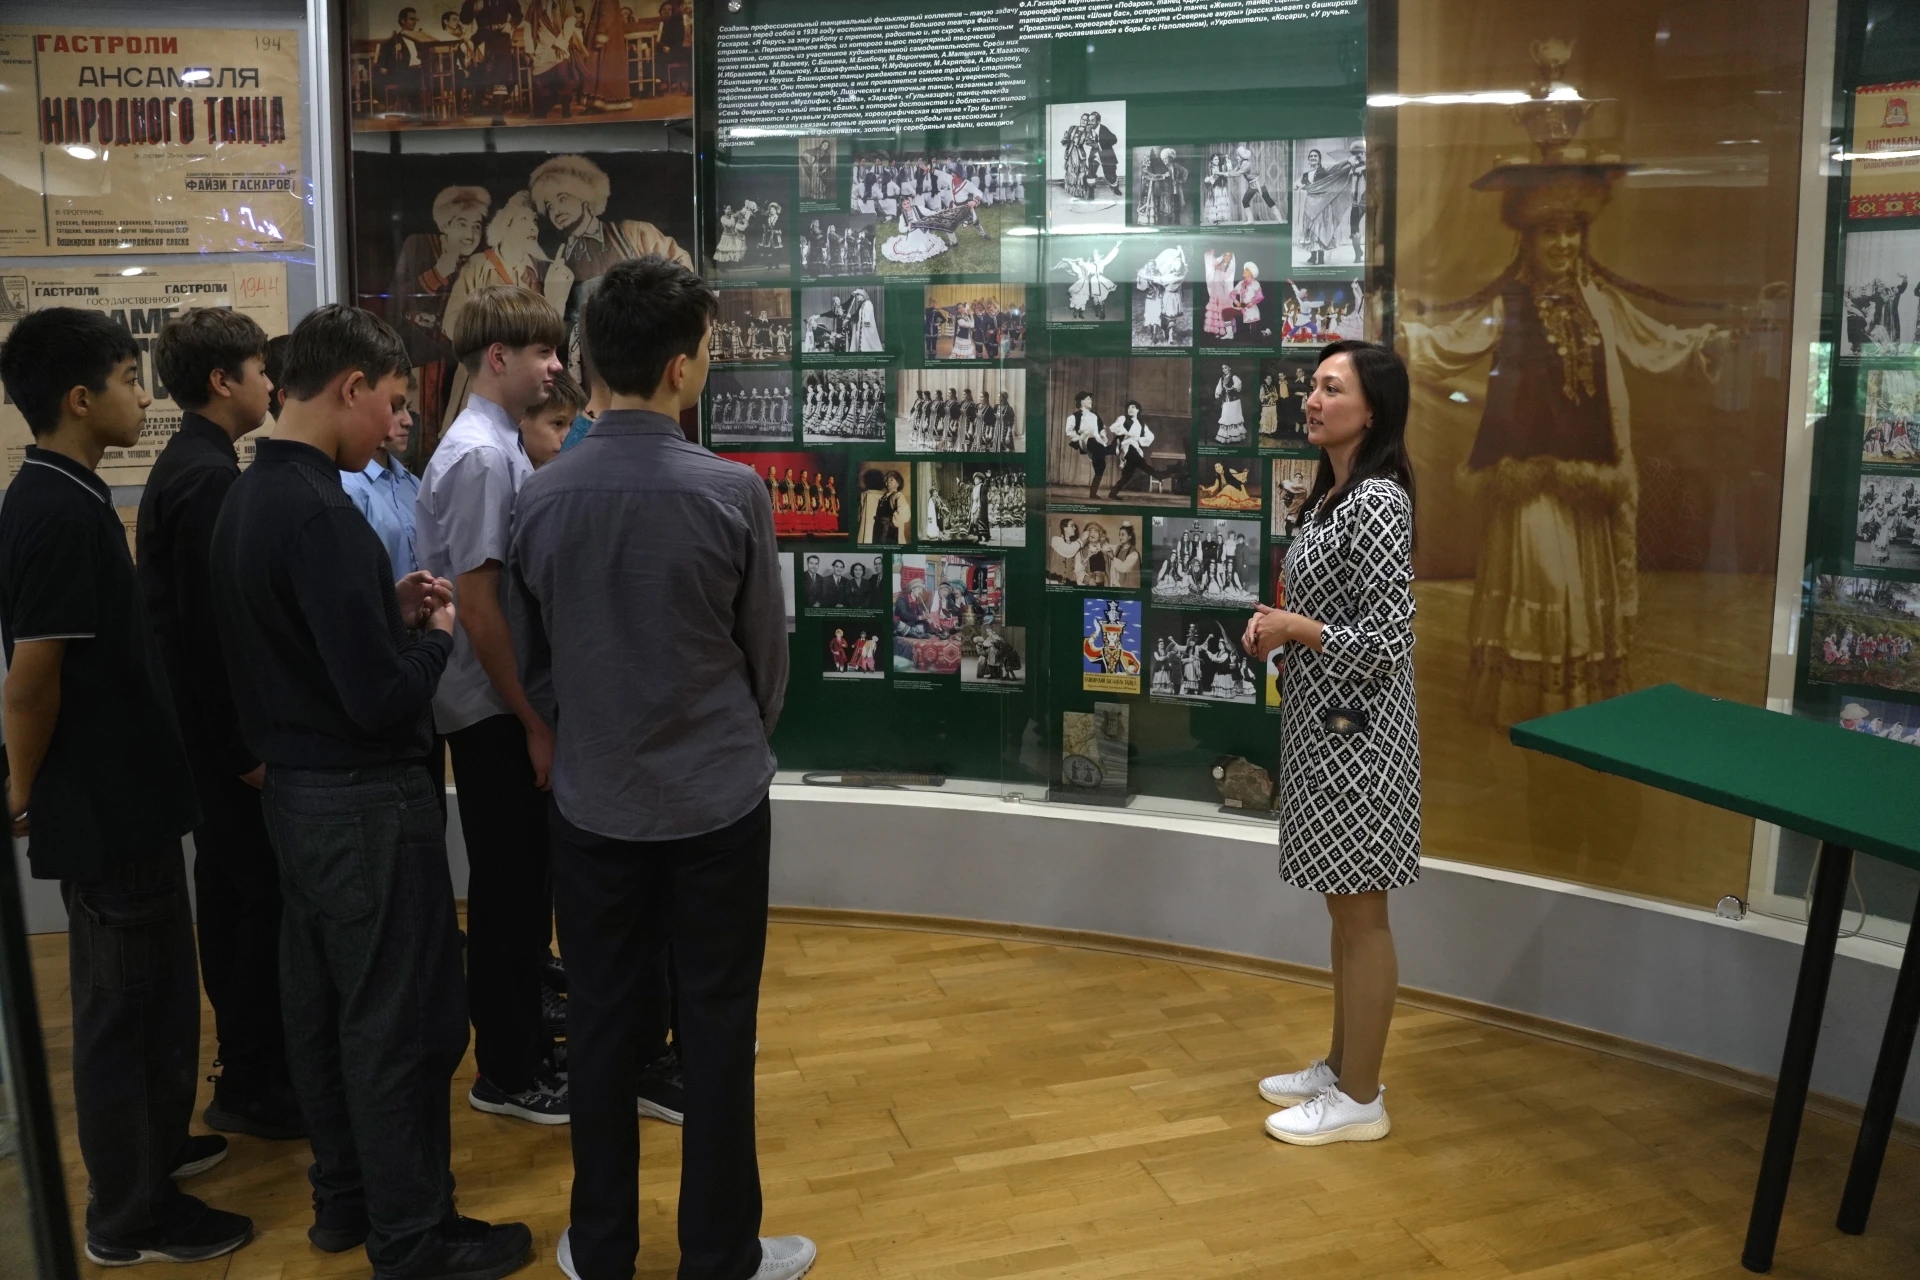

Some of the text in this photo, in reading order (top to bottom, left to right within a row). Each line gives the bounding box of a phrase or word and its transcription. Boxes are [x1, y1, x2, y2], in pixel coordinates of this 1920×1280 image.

[1018, 15, 1059, 25] татарский
[1061, 14, 1085, 22] танец
[1133, 5, 1181, 16] остроумный
[1183, 4, 1207, 12] танец
[1209, 1, 1244, 9] «Жених»,
[1019, 6, 1086, 16] хореографическая
[1087, 4, 1112, 12] сценка
[1114, 0, 1155, 9] «Подарок»,
[1019, 24, 1073, 33] «Проказницы»,
[1074, 18, 1142, 29] хореографическая
[1172, 13, 1213, 21] «Северные
[1214, 10, 1243, 18] амуры»
[1245, 5, 1302, 16] (рассказывает
[1311, 0, 1357, 9] башкирских
[717, 32, 751, 40] поставил
[752, 30, 773, 38] перед
[774, 28, 795, 36] собой
[803, 27, 818, 35] 1938
[819, 26, 835, 34] году
[836, 24, 882, 33] воспитанник
[910, 20, 945, 28] Большого
[976, 16, 998, 24] Файзи
[750, 19, 818, 31] профессиональный
[820, 16, 872, 26] танцевальный
[873, 13, 922, 24] фольклорный
[924, 11, 962, 19] коллектив
[995, 7, 1018, 15] задачу
[1019, 10, 1350, 41] конниках, прославившихся борьбе Наполеоном), «Укротители», «Косари», ручья».
[36, 34, 178, 54] ГАСТРОЛИ
[254, 36, 282, 51] 194
[717, 24, 1013, 48] Гаскаров. берусь работу трепетом, радостью скрою, некоторым
[761, 32, 995, 53] Первоначальное ядро, которого вырос популярный творческий
[717, 39, 1004, 63] коллектив, сложилось участников художественной самодеятельности. Среди
[717, 64, 738, 72] нужно
[849, 55, 887, 63] М.Бикбову,
[717, 70, 767, 78] И.Ибрагимова,
[882, 61, 932, 69] Н.Мударисову,
[978, 56, 1020, 64] А.Морозову,
[770, 76, 795, 84] других.
[865, 70, 906, 79] рождаются
[944, 64, 979, 74] традиций
[981, 63, 1021, 71] старинных
[78, 66, 259, 88] АНСАМБЛЯ
[717, 86, 751, 95] народных
[819, 81, 849, 89] энергии,
[870, 78, 917, 87] проявляется
[717, 101, 758, 109] башкирских
[956, 87, 1008, 96] танец-легенда
[770, 91, 811, 99] свободному
[812, 89, 838, 97] народу.
[840, 87, 880, 96] Лирические
[888, 85, 926, 93] шуточные
[927, 83, 954, 91] танцы,
[955, 81, 993, 89] названные
[741, 108, 776, 116] девушек»;
[777, 106, 807, 114] сольный
[898, 99, 947, 107] достоинство
[791, 114, 821, 122] лукавым
[822, 112, 863, 120] ухарством,
[864, 108, 929, 118] хореографическая
[931, 106, 961, 114] картина
[963, 105, 979, 113] «Три
[980, 104, 1007, 112] брата»
[42, 96, 286, 147] НАРОДНОГО ТАНЦА
[858, 118, 886, 126] громкие
[888, 117, 914, 125] успехи,
[915, 115, 942, 123] победы
[953, 113, 996, 121] всесоюзных
[902, 123, 945, 132] серебряные
[946, 121, 974, 129] медали,
[187, 179, 291, 190] ФАЙЗИ ГАСКАРОВ
[57, 237, 95, 246] башкирская
[35, 283, 227, 296] ГАСТРОЛИ ГАСТРОЛИ
[239, 275, 279, 298] 1944
[86, 296, 180, 306] ГОСУДАРСТВЕННОГО
